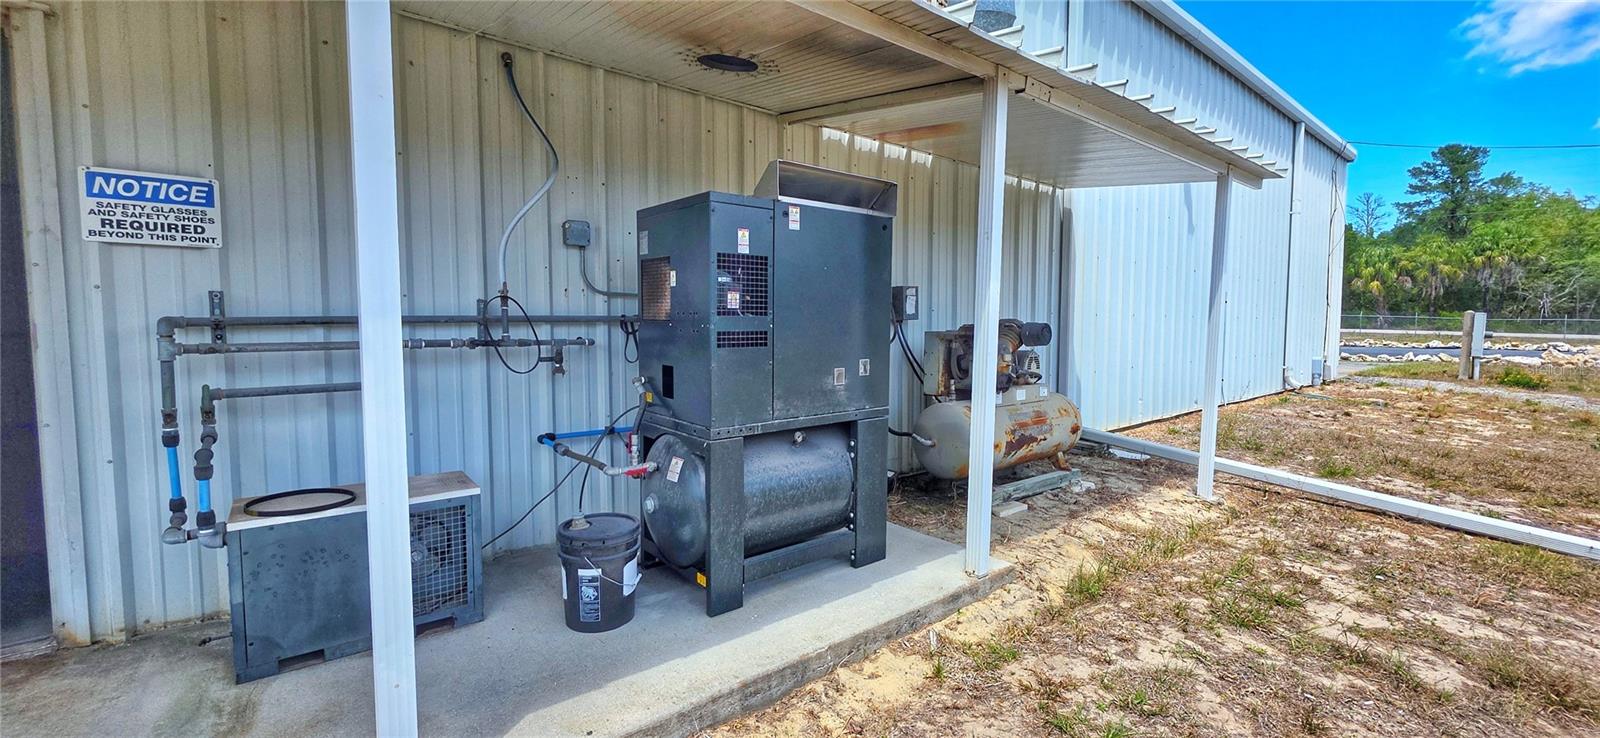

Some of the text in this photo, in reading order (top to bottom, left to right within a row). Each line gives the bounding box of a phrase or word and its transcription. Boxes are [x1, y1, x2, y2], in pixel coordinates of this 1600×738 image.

[92, 176, 209, 203] NOTICE
[88, 208, 215, 225] AND SAFETY SHOES
[96, 201, 208, 217] SAFETY GLASSES
[100, 218, 206, 235] REQUIRED
[88, 230, 217, 244] BEYOND THIS POINT
